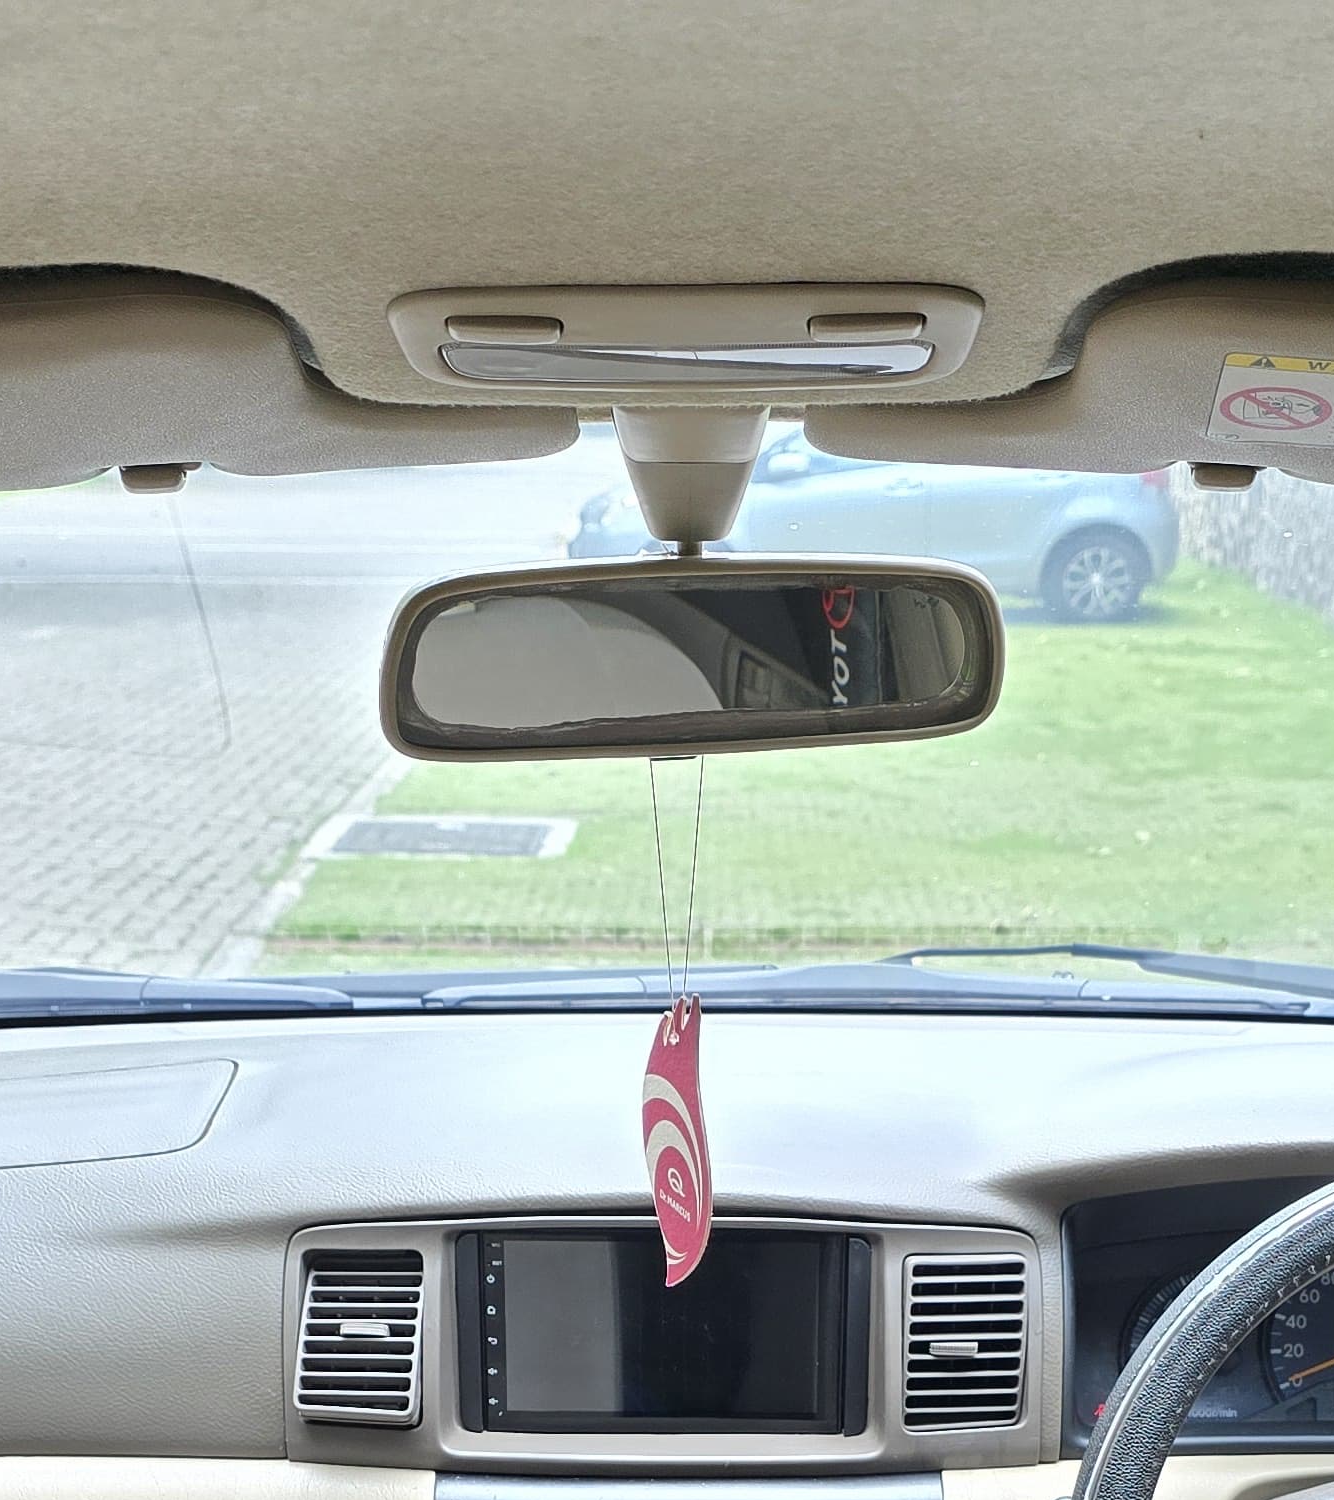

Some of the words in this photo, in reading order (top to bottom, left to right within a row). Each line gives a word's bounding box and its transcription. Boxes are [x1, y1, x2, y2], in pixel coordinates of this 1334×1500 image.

[1299, 1289, 1320, 1303] 60
[1285, 1315, 1307, 1329] 40
[1283, 1343, 1304, 1358] 20
